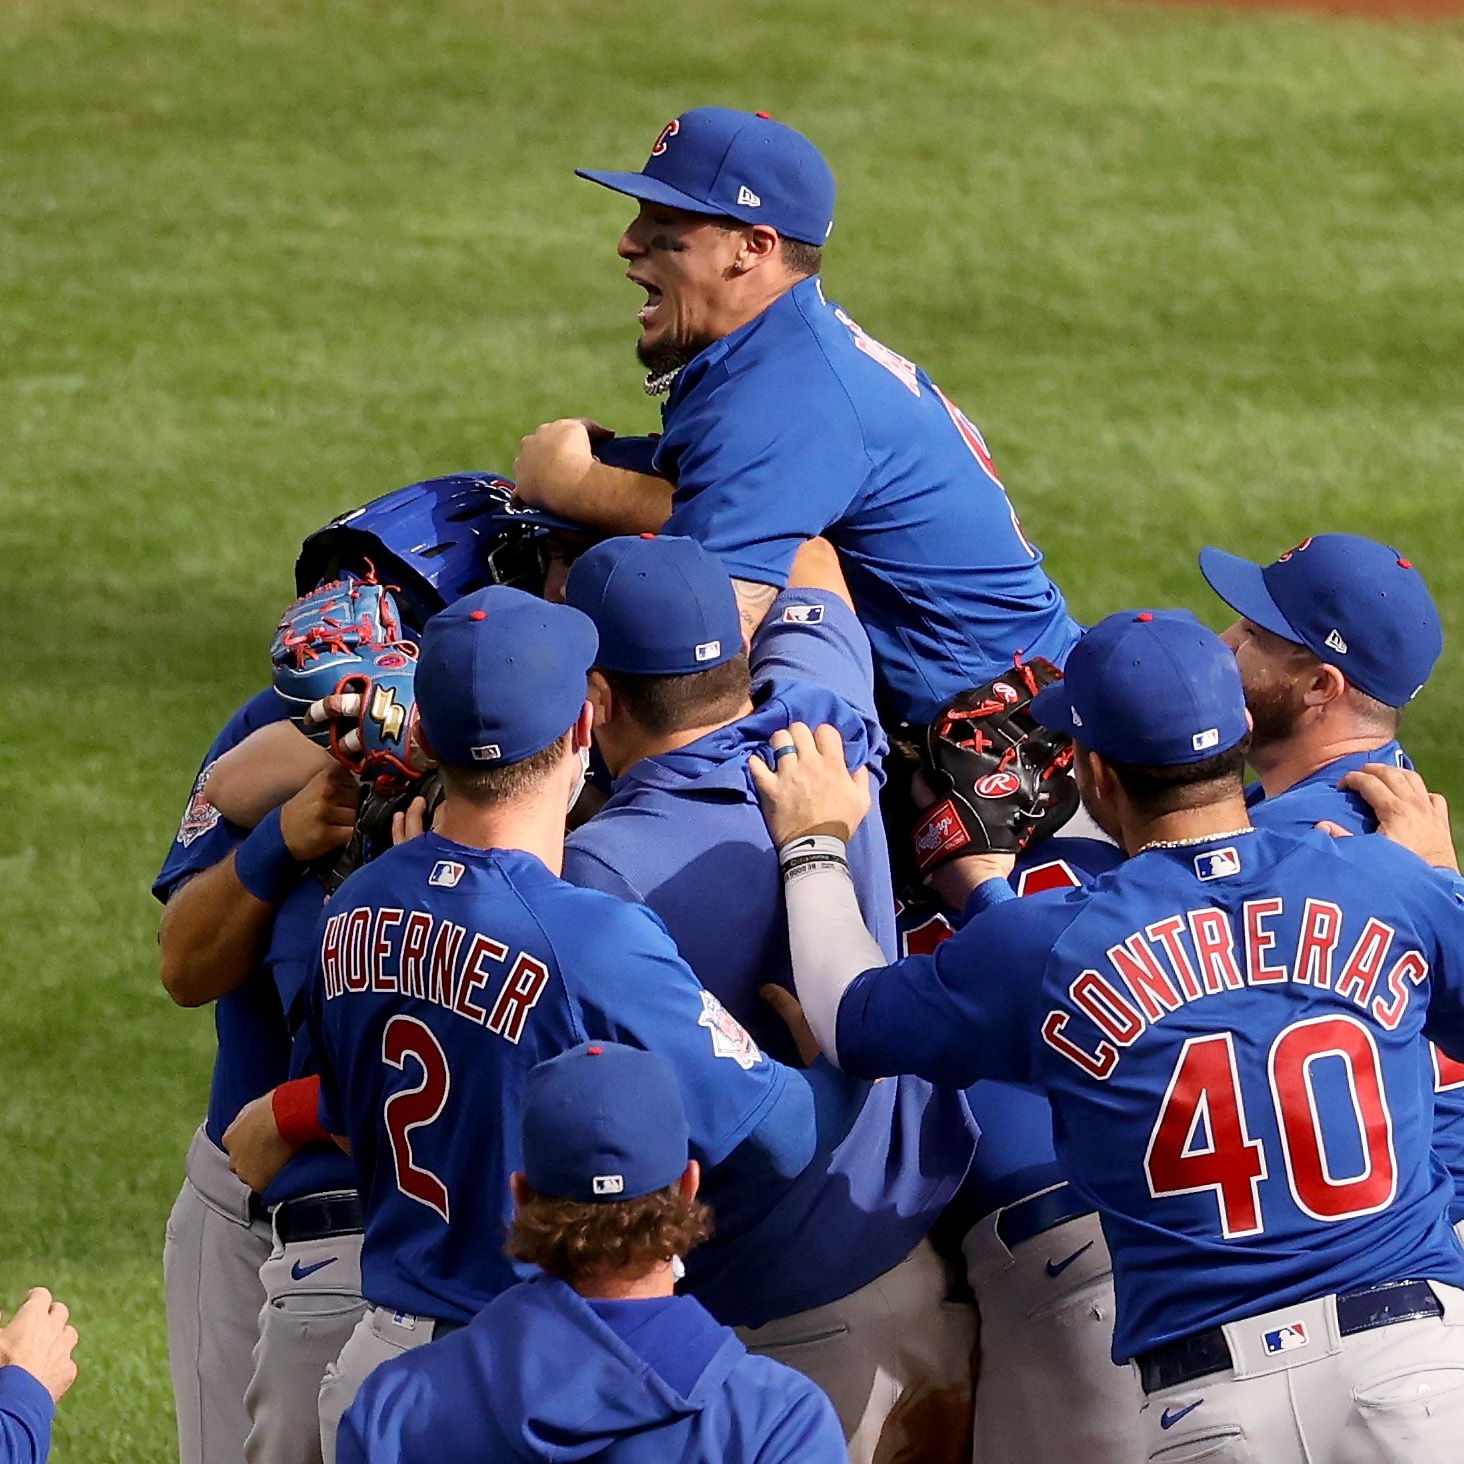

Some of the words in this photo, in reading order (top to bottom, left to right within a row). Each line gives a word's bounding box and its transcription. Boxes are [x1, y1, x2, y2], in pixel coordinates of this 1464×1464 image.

[979, 773, 1015, 795] R
[321, 907, 550, 1045] HOERNER
[1041, 898, 1428, 1080] CONTRERAS
[382, 1014, 451, 1225] 2
[1143, 1014, 1398, 1239] 40
